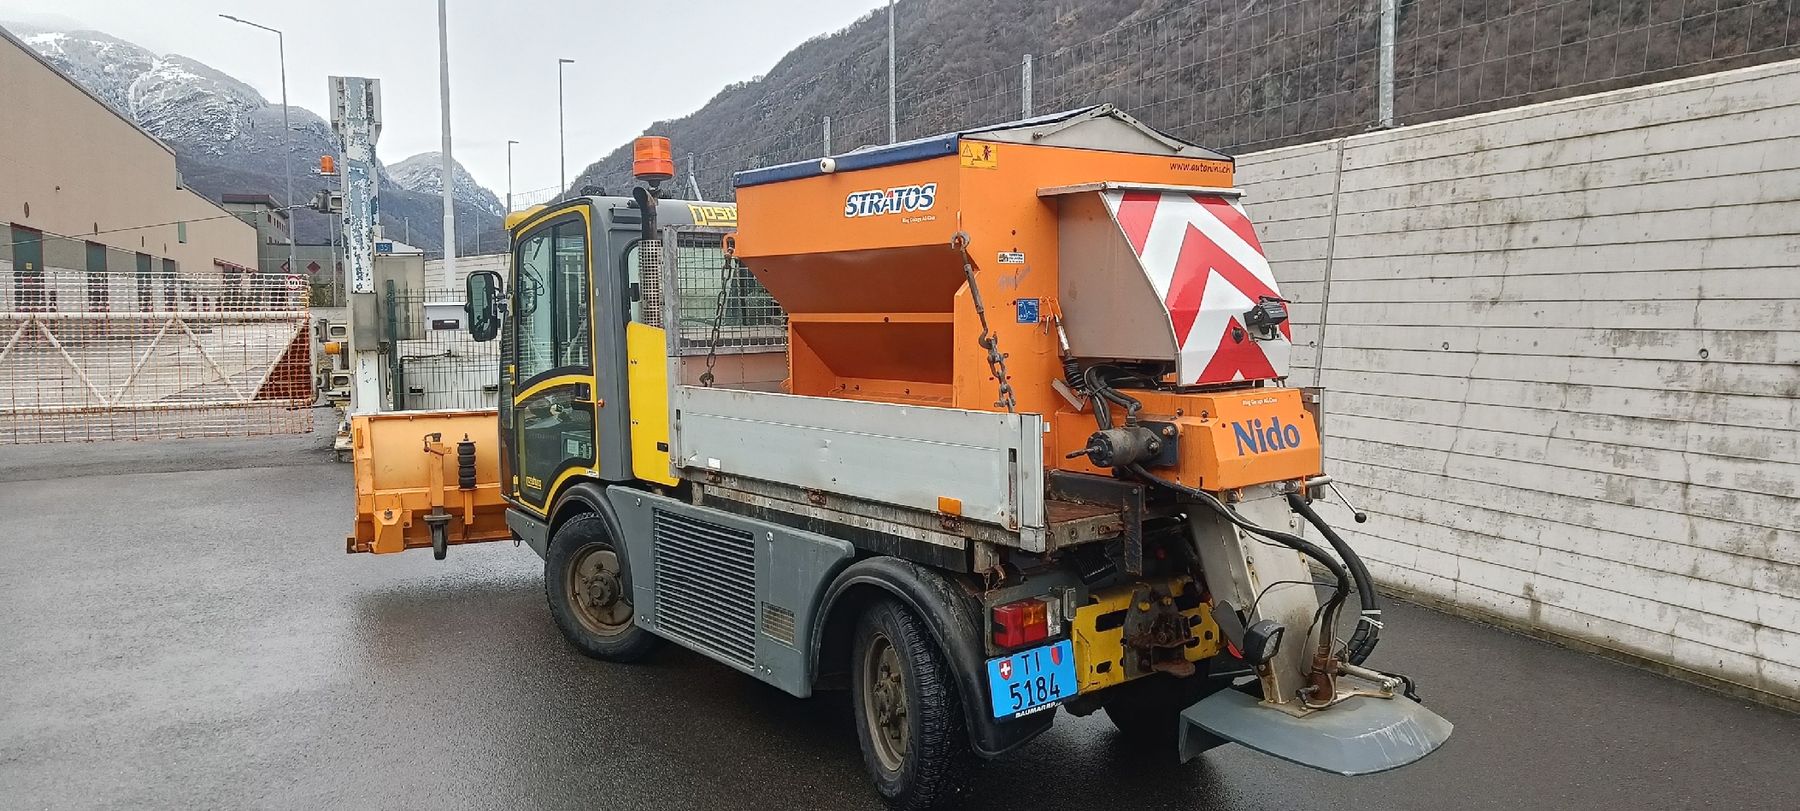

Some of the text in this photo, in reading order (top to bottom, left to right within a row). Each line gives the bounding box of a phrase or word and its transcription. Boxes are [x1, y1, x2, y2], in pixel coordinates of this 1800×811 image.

[845, 183, 937, 217] STRATOS
[1231, 416, 1301, 457] Nido
[1021, 651, 1040, 675] TI
[1009, 673, 1060, 710] 5184
